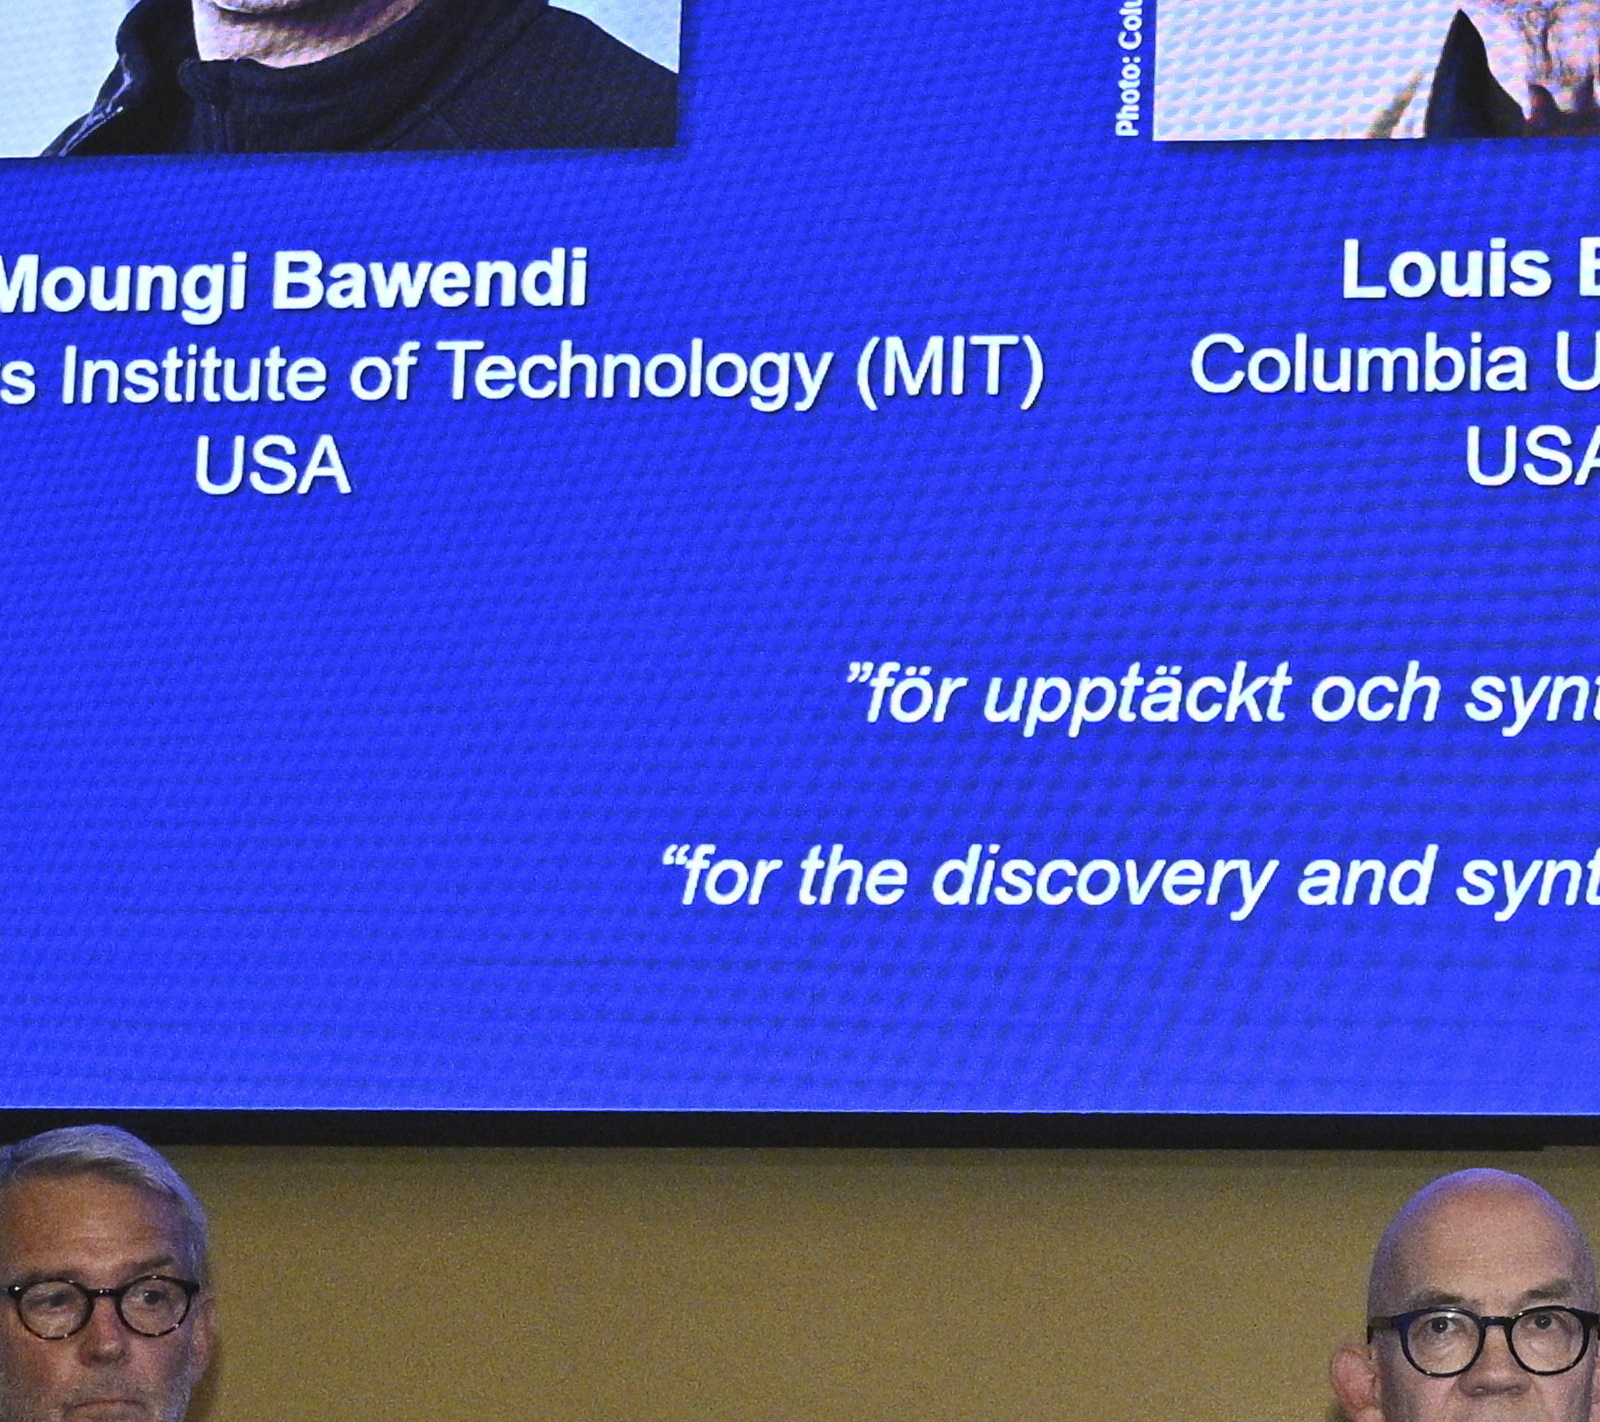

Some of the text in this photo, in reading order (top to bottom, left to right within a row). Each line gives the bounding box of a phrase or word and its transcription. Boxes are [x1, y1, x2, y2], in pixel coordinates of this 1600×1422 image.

[1116, 57, 1140, 136] Photo:
[273, 247, 587, 309] Bawendi
[1344, 238, 1551, 298] Louis
[63, 344, 326, 403] Institute
[351, 342, 420, 400] of
[436, 338, 833, 411] Technology
[858, 335, 1043, 410] (MIT)
[1191, 332, 1526, 392] Columbia
[196, 435, 351, 494] USA
[984, 661, 1292, 737] upptäckt
[1312, 661, 1441, 721] och
[799, 844, 907, 905] the
[933, 844, 1279, 921] discovery
[1298, 844, 1438, 905] and
